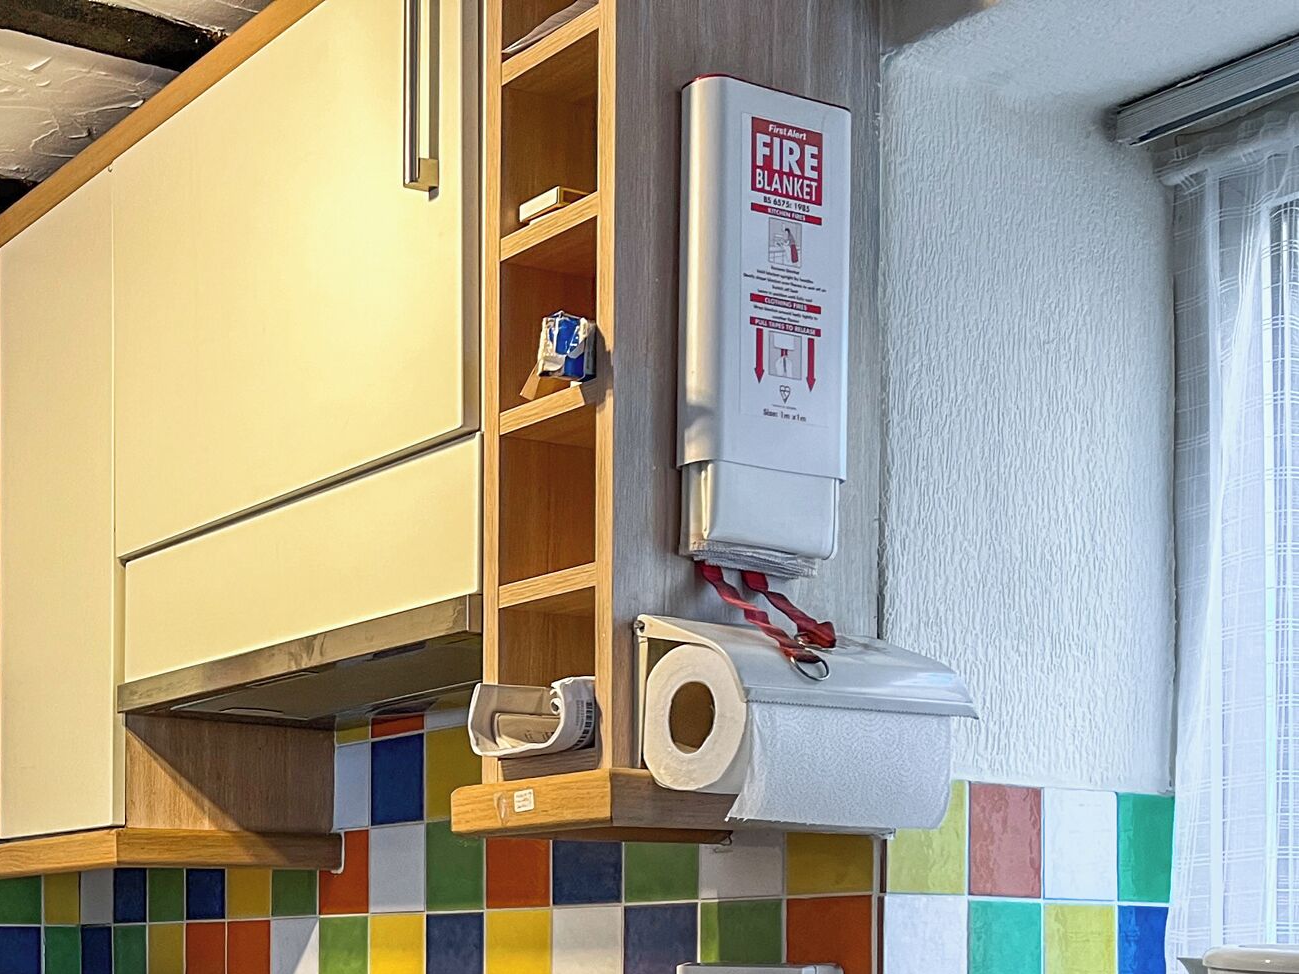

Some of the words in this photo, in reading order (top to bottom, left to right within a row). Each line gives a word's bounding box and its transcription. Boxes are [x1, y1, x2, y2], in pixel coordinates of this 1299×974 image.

[768, 124, 786, 136] First
[787, 129, 807, 141] Alert
[756, 132, 819, 180] FIRE
[756, 168, 818, 201] BLANKET
